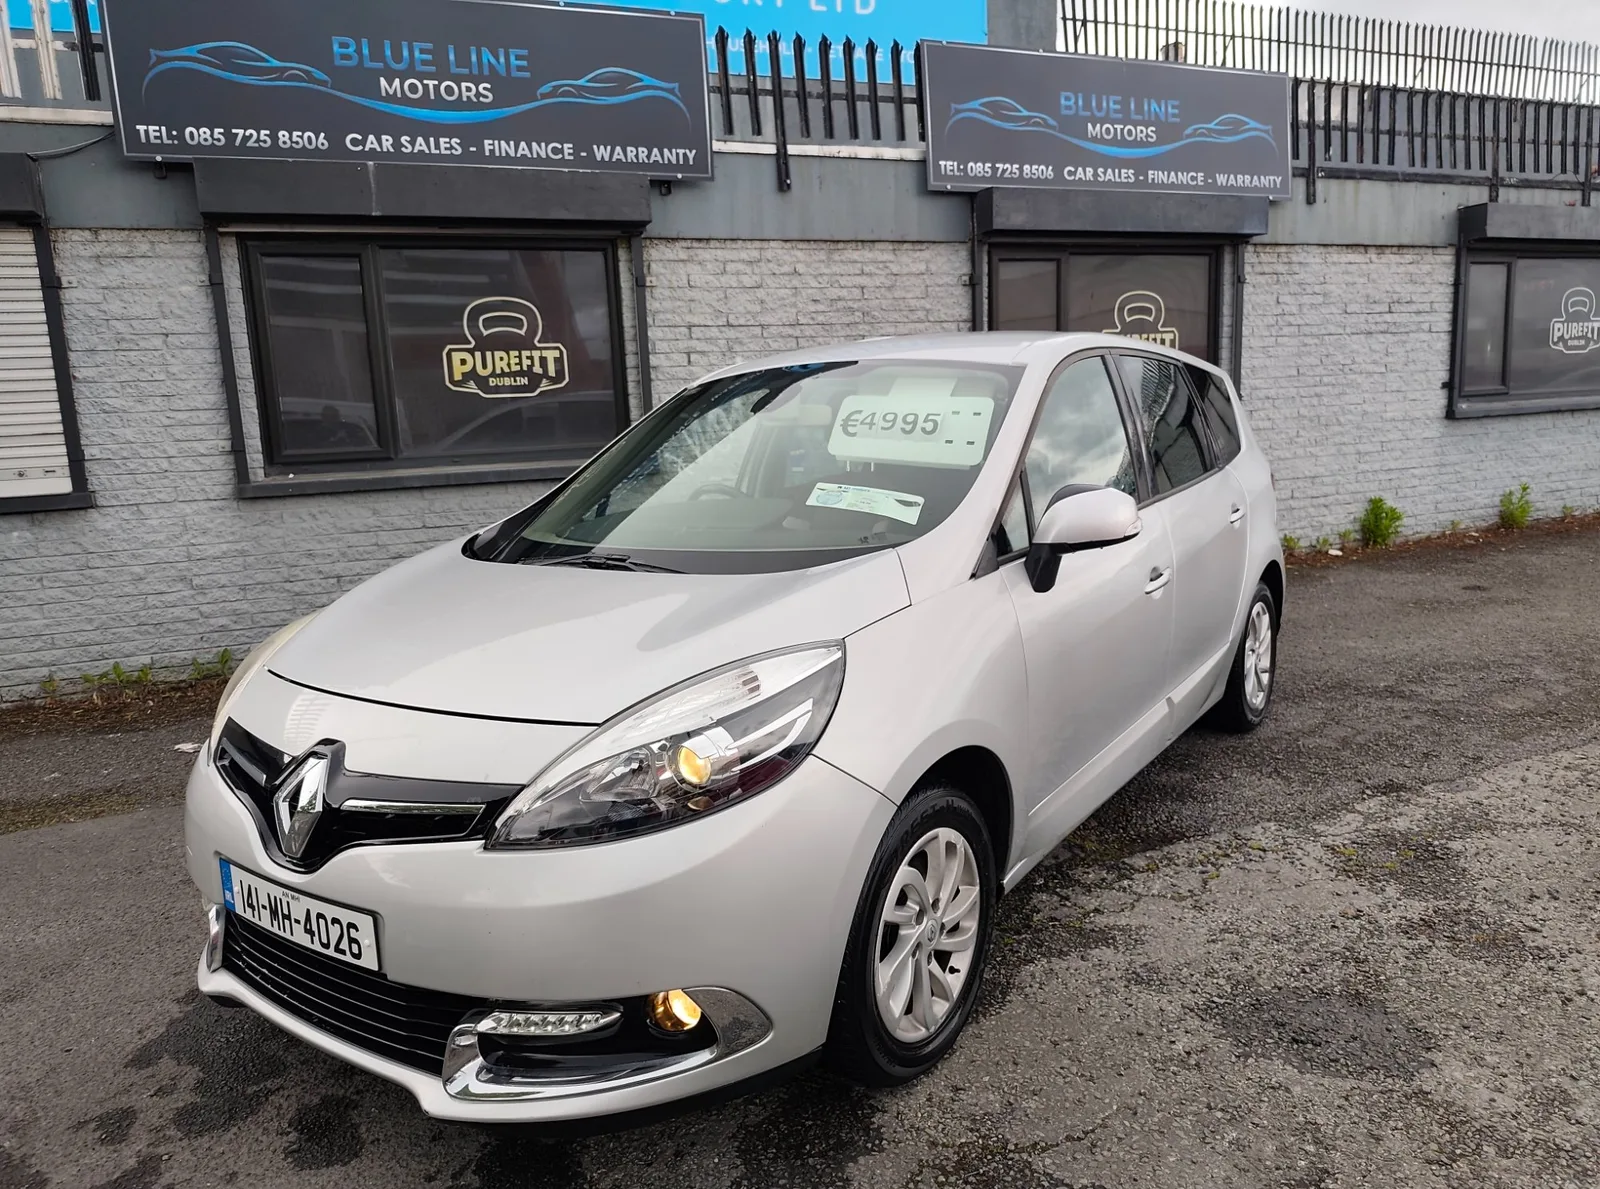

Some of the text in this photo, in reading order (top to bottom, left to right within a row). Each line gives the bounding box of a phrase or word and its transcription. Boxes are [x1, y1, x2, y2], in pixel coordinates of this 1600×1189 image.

[331, 36, 531, 78] BLUE LINE
[379, 76, 494, 103] MOTORS
[1060, 91, 1181, 122] BLUE LINE
[136, 124, 178, 145] TEL:
[184, 126, 225, 147] 085
[231, 128, 271, 148] 725
[278, 130, 329, 151] 8506
[345, 133, 394, 153] CAR
[400, 136, 462, 155] SALES
[483, 139, 574, 160] FINANCE
[592, 144, 697, 166] WARRANTY
[1087, 122, 1157, 143] MOTORS
[939, 160, 964, 177] TEL:
[967, 162, 992, 178] 085
[995, 164, 1020, 178] 725
[1022, 165, 1054, 180] 8506
[1063, 166, 1094, 181] CAR
[1097, 167, 1135, 183] SALES
[1148, 170, 1205, 186] FINANCE
[1216, 173, 1283, 189] WARRANTY
[1553, 322, 1600, 342] PUREFIT
[451, 350, 560, 381] PUREFIT
[488, 376, 529, 386] DUBLIN
[840, 409, 942, 438] €4995
[239, 879, 363, 962] 141-MH-4026
